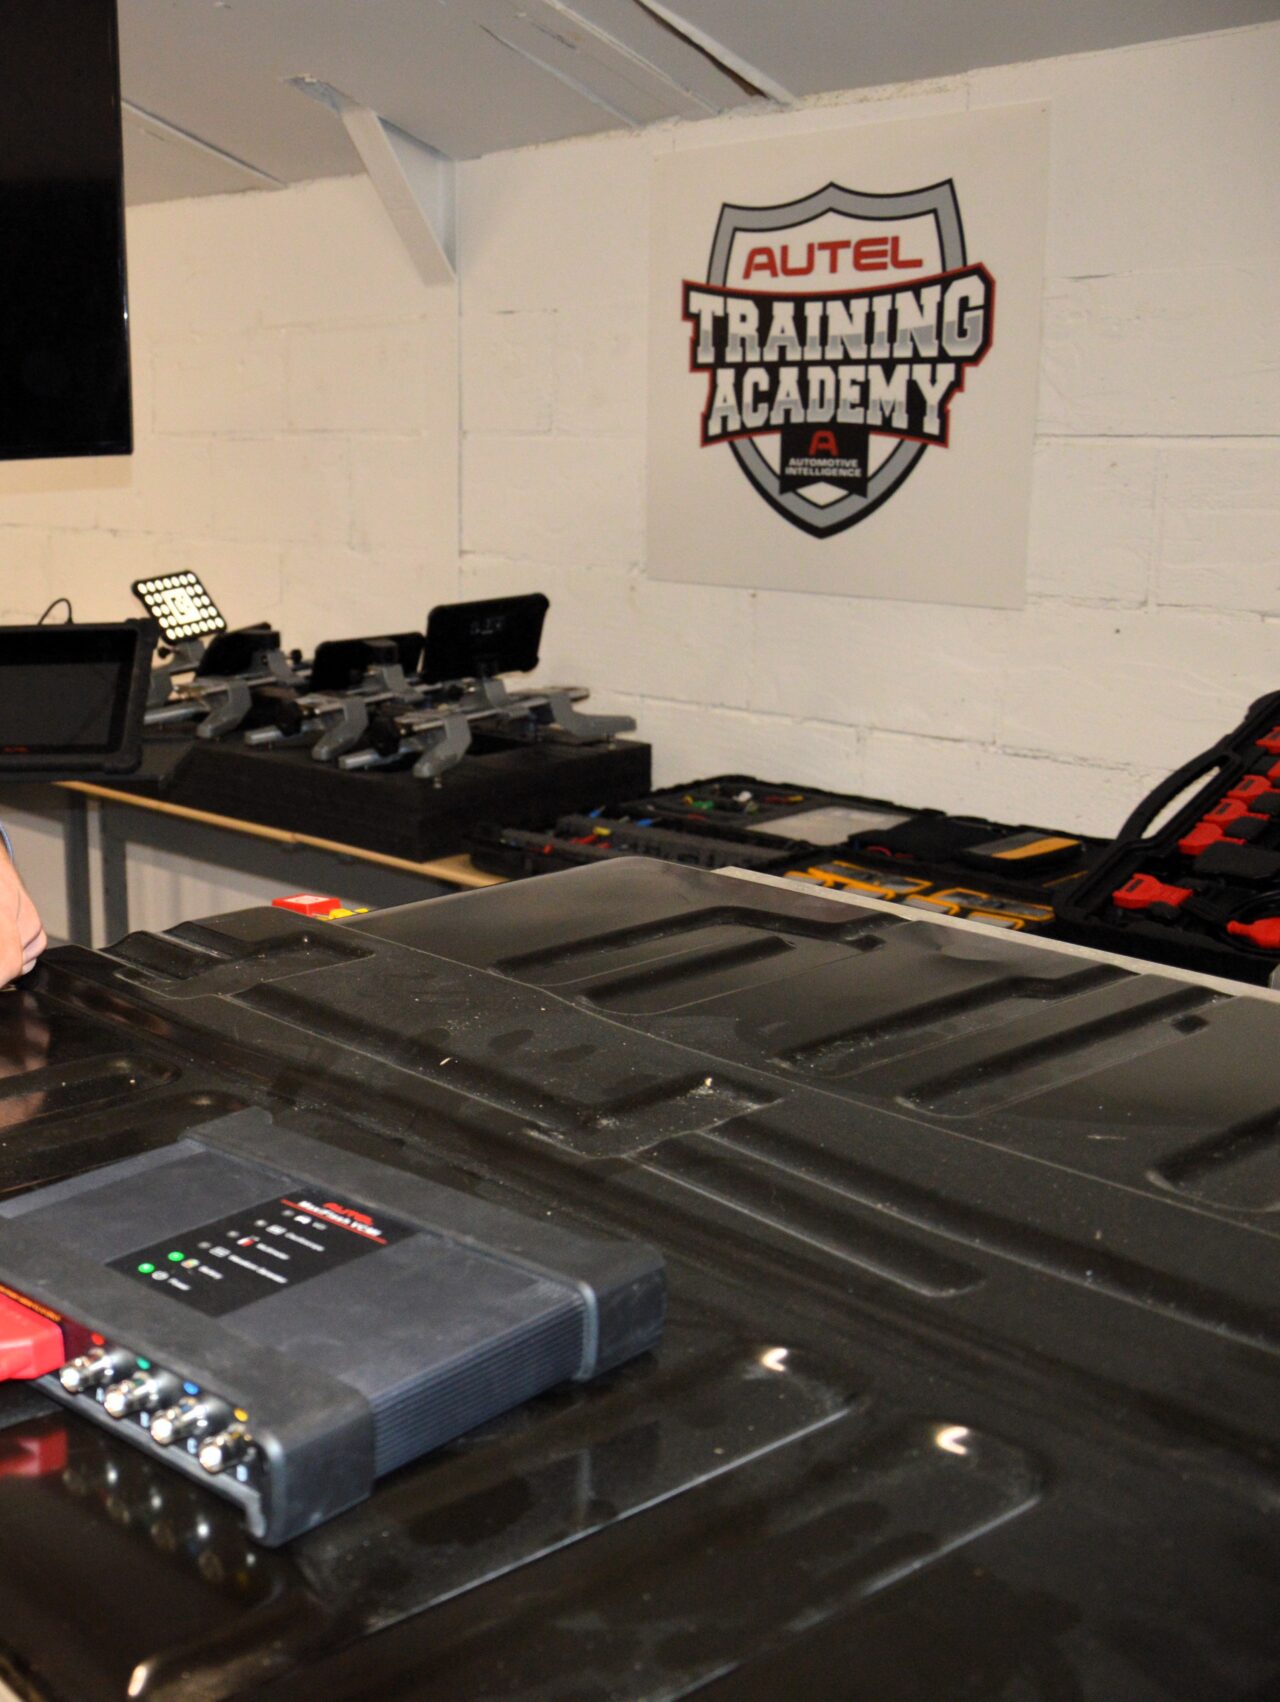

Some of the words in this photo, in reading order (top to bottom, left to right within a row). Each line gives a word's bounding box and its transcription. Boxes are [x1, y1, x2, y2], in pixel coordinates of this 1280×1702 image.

[742, 235, 923, 280] AUTEL
[688, 273, 986, 364] TRAINING
[707, 362, 956, 437] ACADEMY
[784, 466, 862, 478] INTELLIGENCE
[788, 457, 859, 468] AUTOMOTIVE
